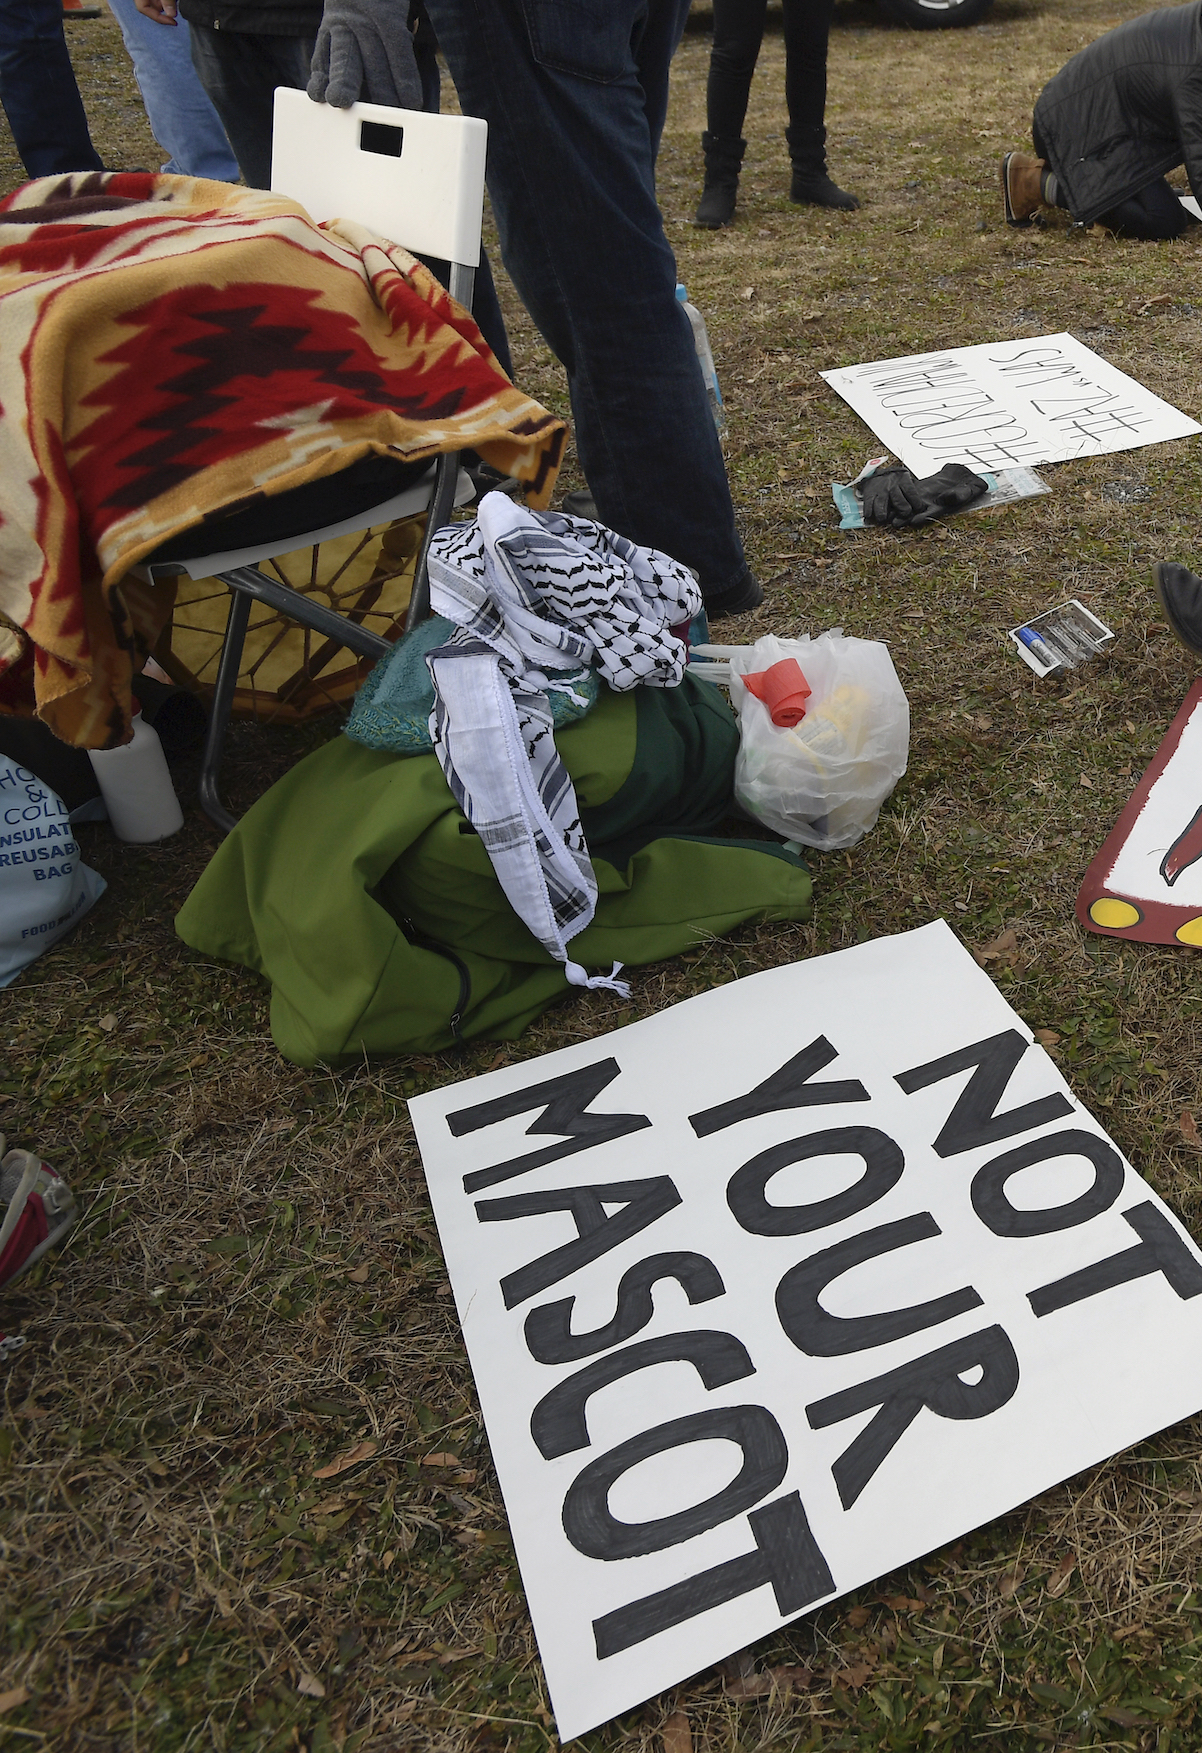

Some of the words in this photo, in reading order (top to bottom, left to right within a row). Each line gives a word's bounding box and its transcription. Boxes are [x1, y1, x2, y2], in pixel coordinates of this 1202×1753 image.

[989, 348, 1082, 389] WAS
[1030, 385, 1153, 442] #AZ
[0, 767, 36, 790] HO
[25, 784, 48, 803] &
[0, 822, 71, 848] NSULAT
[0, 843, 79, 867] REUSAB
[33, 863, 73, 881] BAG
[21, 920, 57, 939] FOOD
[688, 1034, 1020, 1511] YOUR
[446, 1056, 837, 1660] MASCOT
